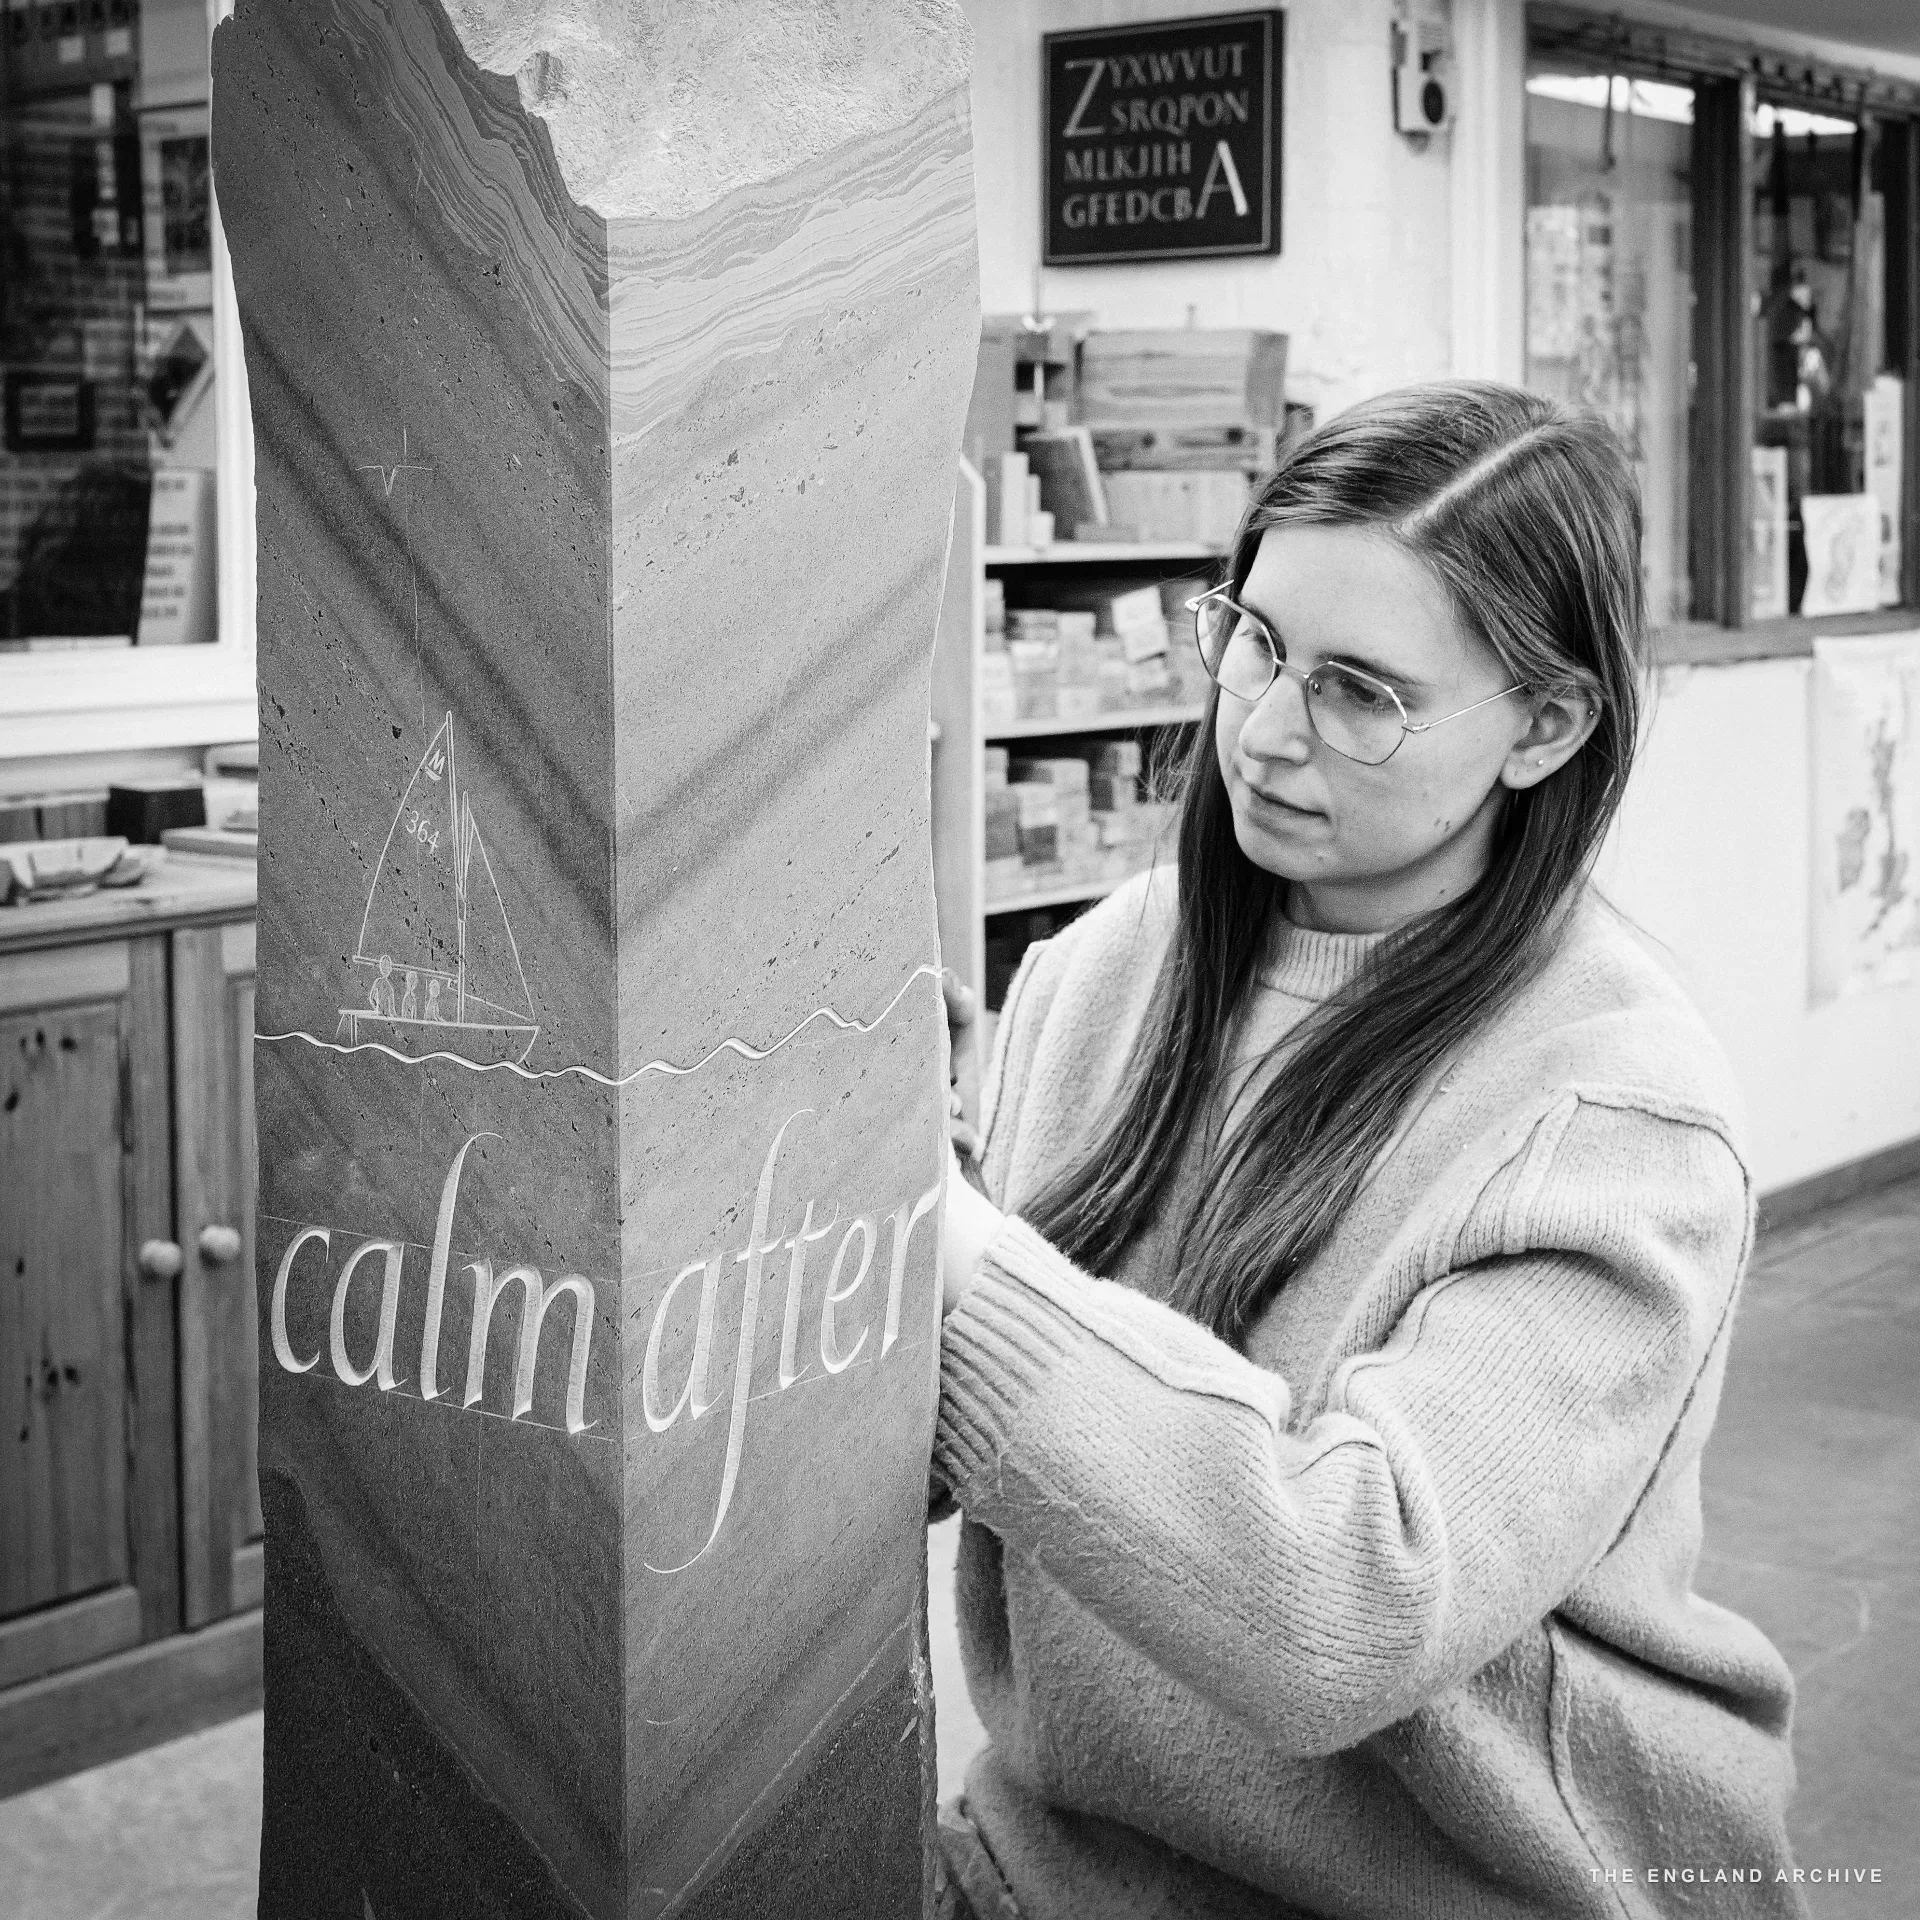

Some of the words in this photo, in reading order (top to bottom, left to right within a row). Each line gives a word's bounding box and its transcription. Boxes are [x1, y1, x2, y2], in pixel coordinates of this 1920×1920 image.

[1111, 90, 1250, 136] SRQPON
[1064, 140, 1192, 182] MLKJIH
[405, 808, 440, 854] 364
[270, 1131, 599, 1435] calm
[642, 1107, 944, 1574] after
